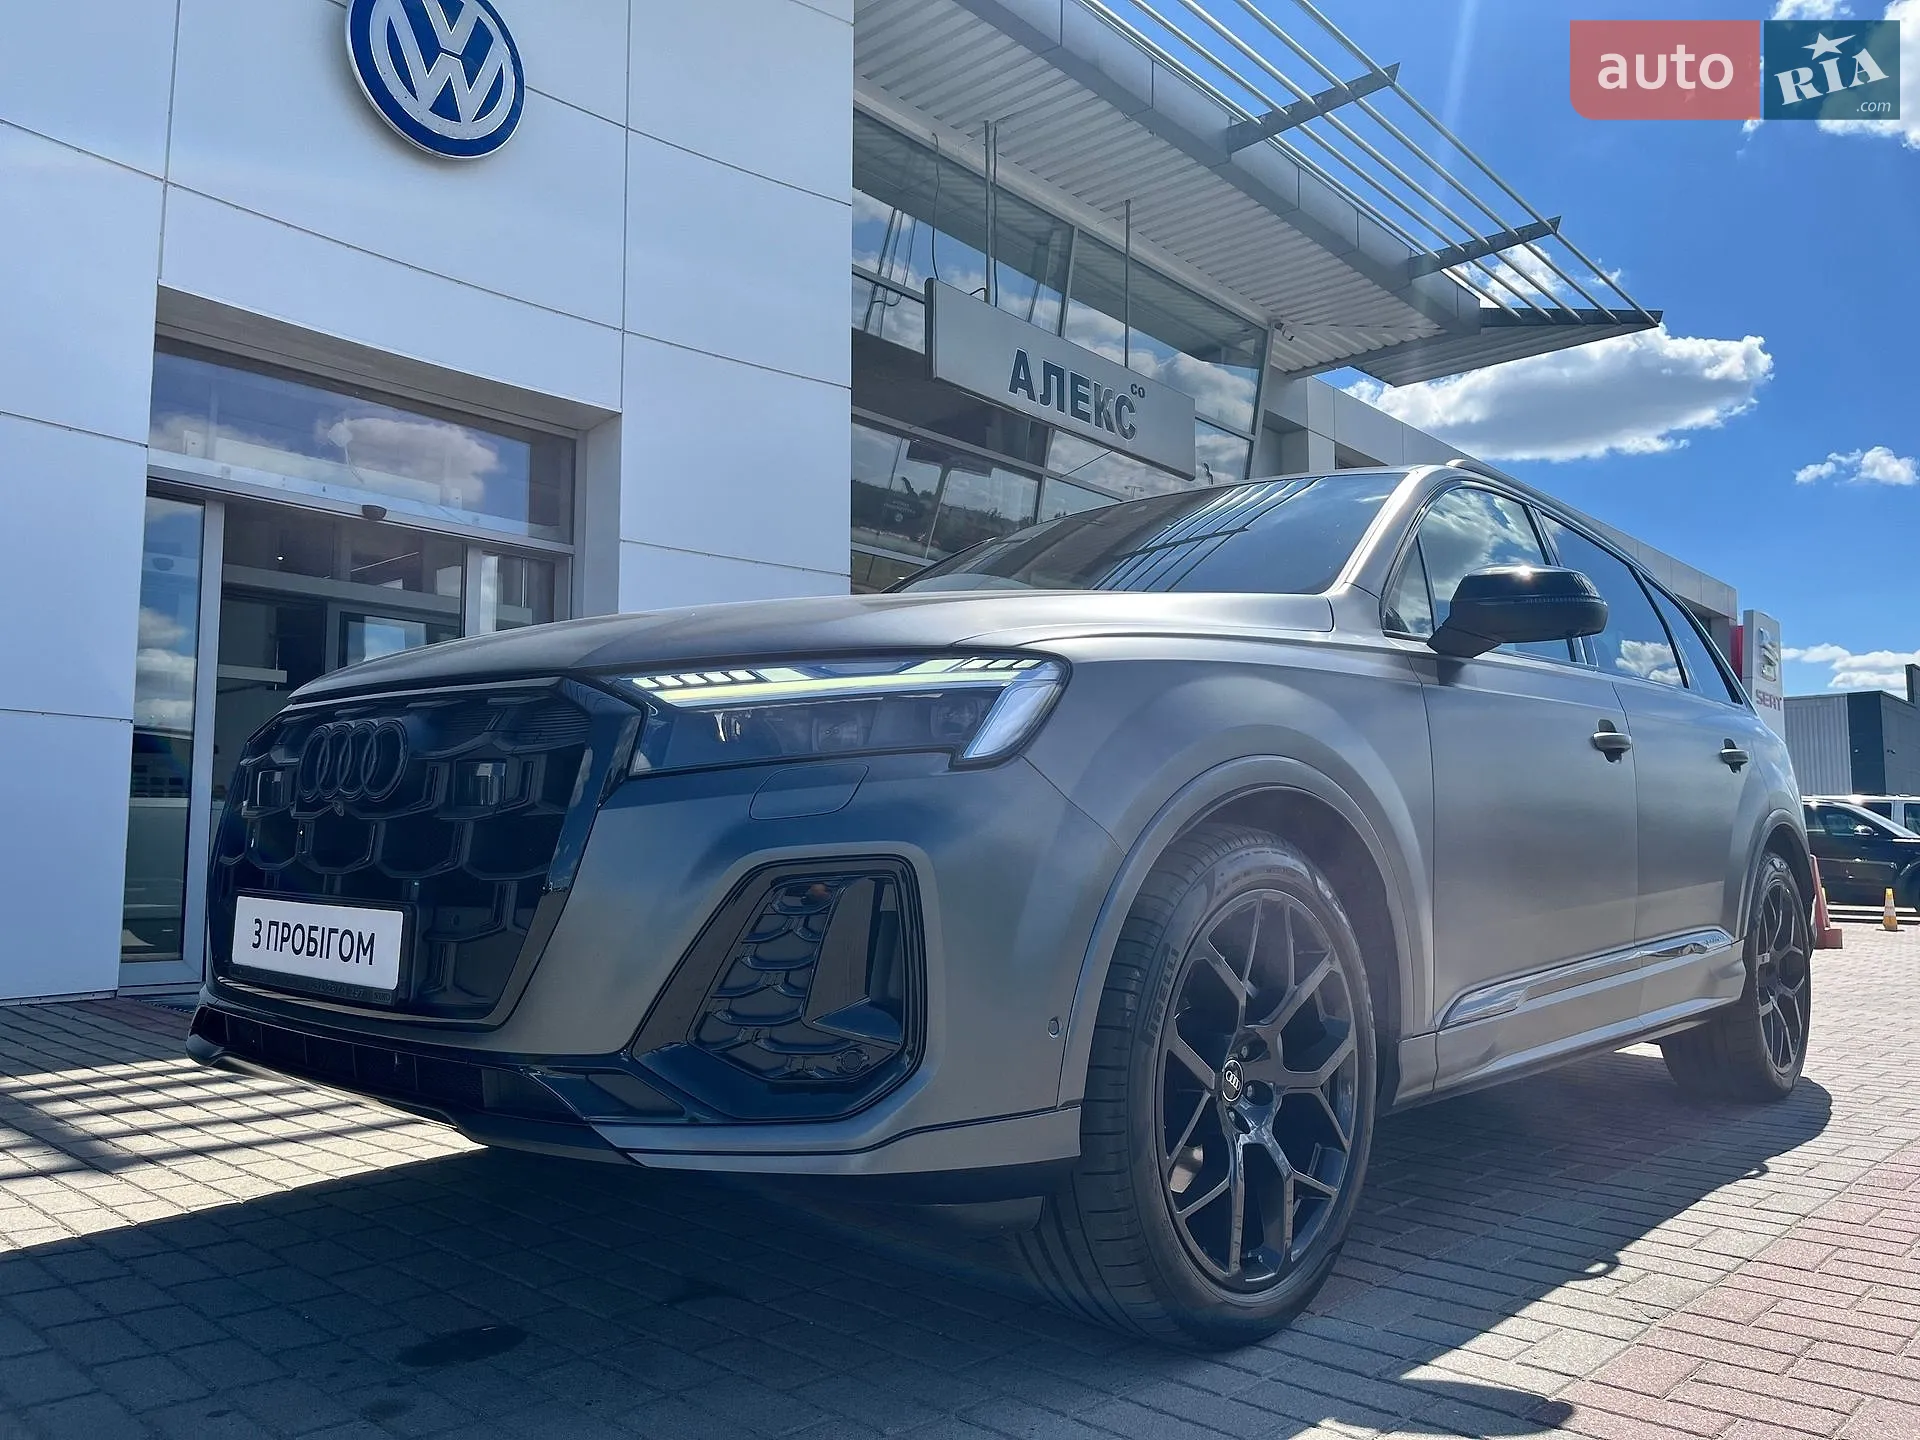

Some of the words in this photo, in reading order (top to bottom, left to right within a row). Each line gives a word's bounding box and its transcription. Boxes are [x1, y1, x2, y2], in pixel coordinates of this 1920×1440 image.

[1008, 348, 1137, 441] АЛЕКС
[1755, 689, 1782, 711] SEAT
[266, 920, 375, 966] ПРОБІГОМ
